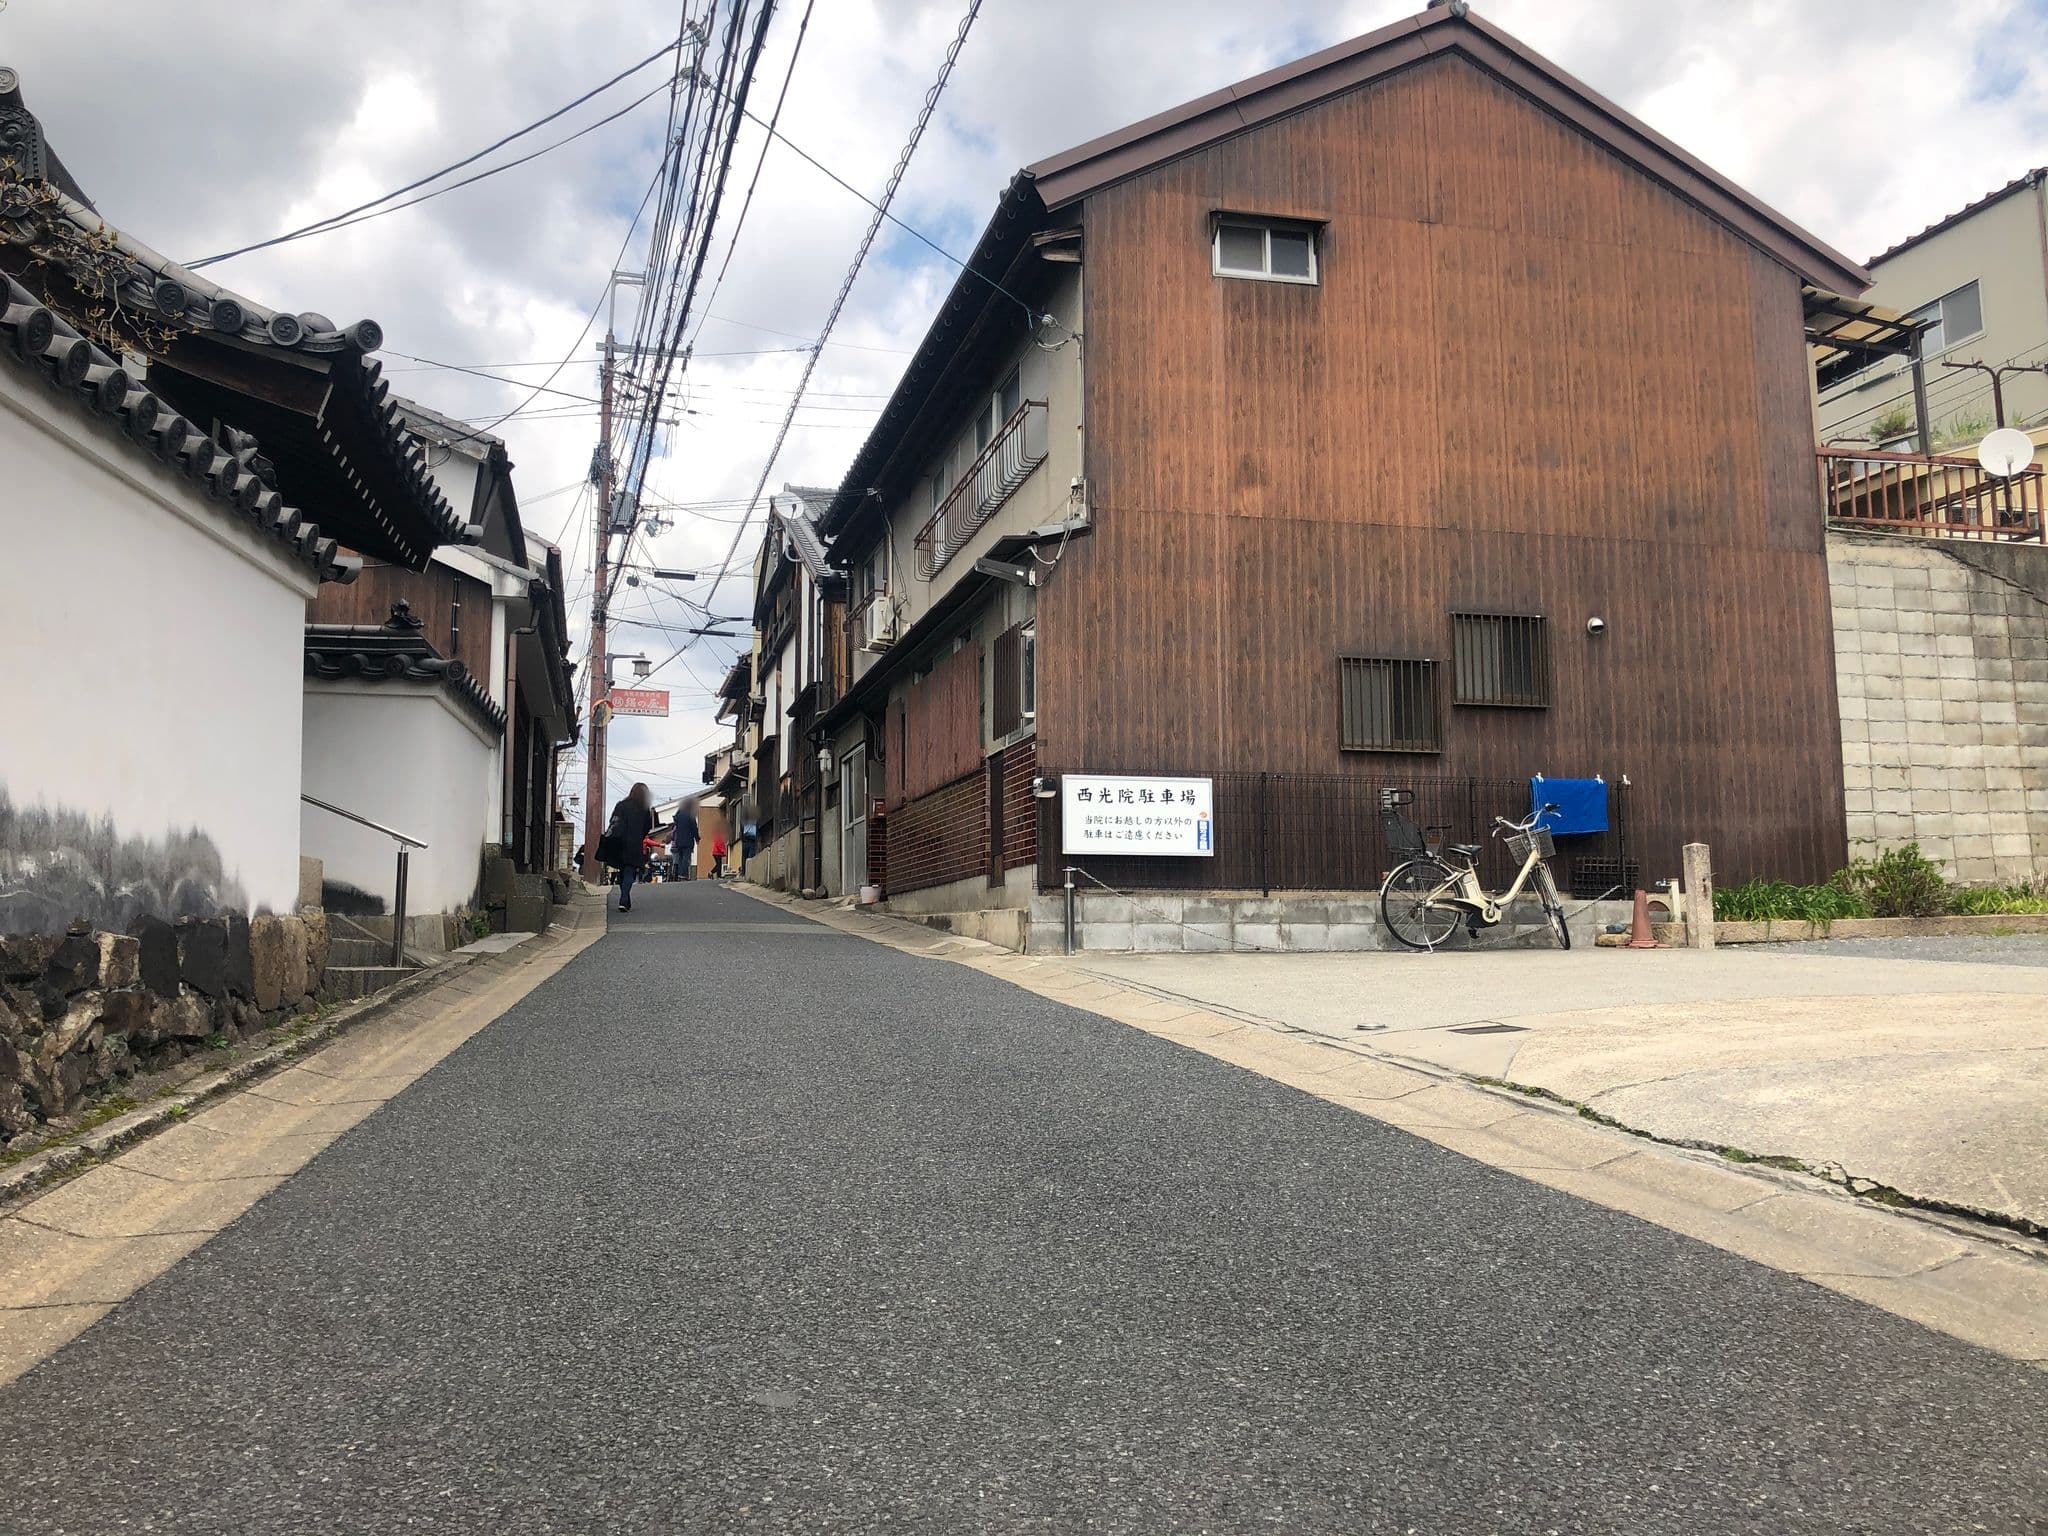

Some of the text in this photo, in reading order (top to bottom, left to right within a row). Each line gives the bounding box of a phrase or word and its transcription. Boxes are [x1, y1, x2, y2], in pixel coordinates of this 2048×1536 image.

[1077, 787, 1196, 806] 西光院駐車場
[1085, 815, 1192, 827] 当院にお越しの方以外の
[1083, 829, 1183, 841] 駐車はご遠慮ください
